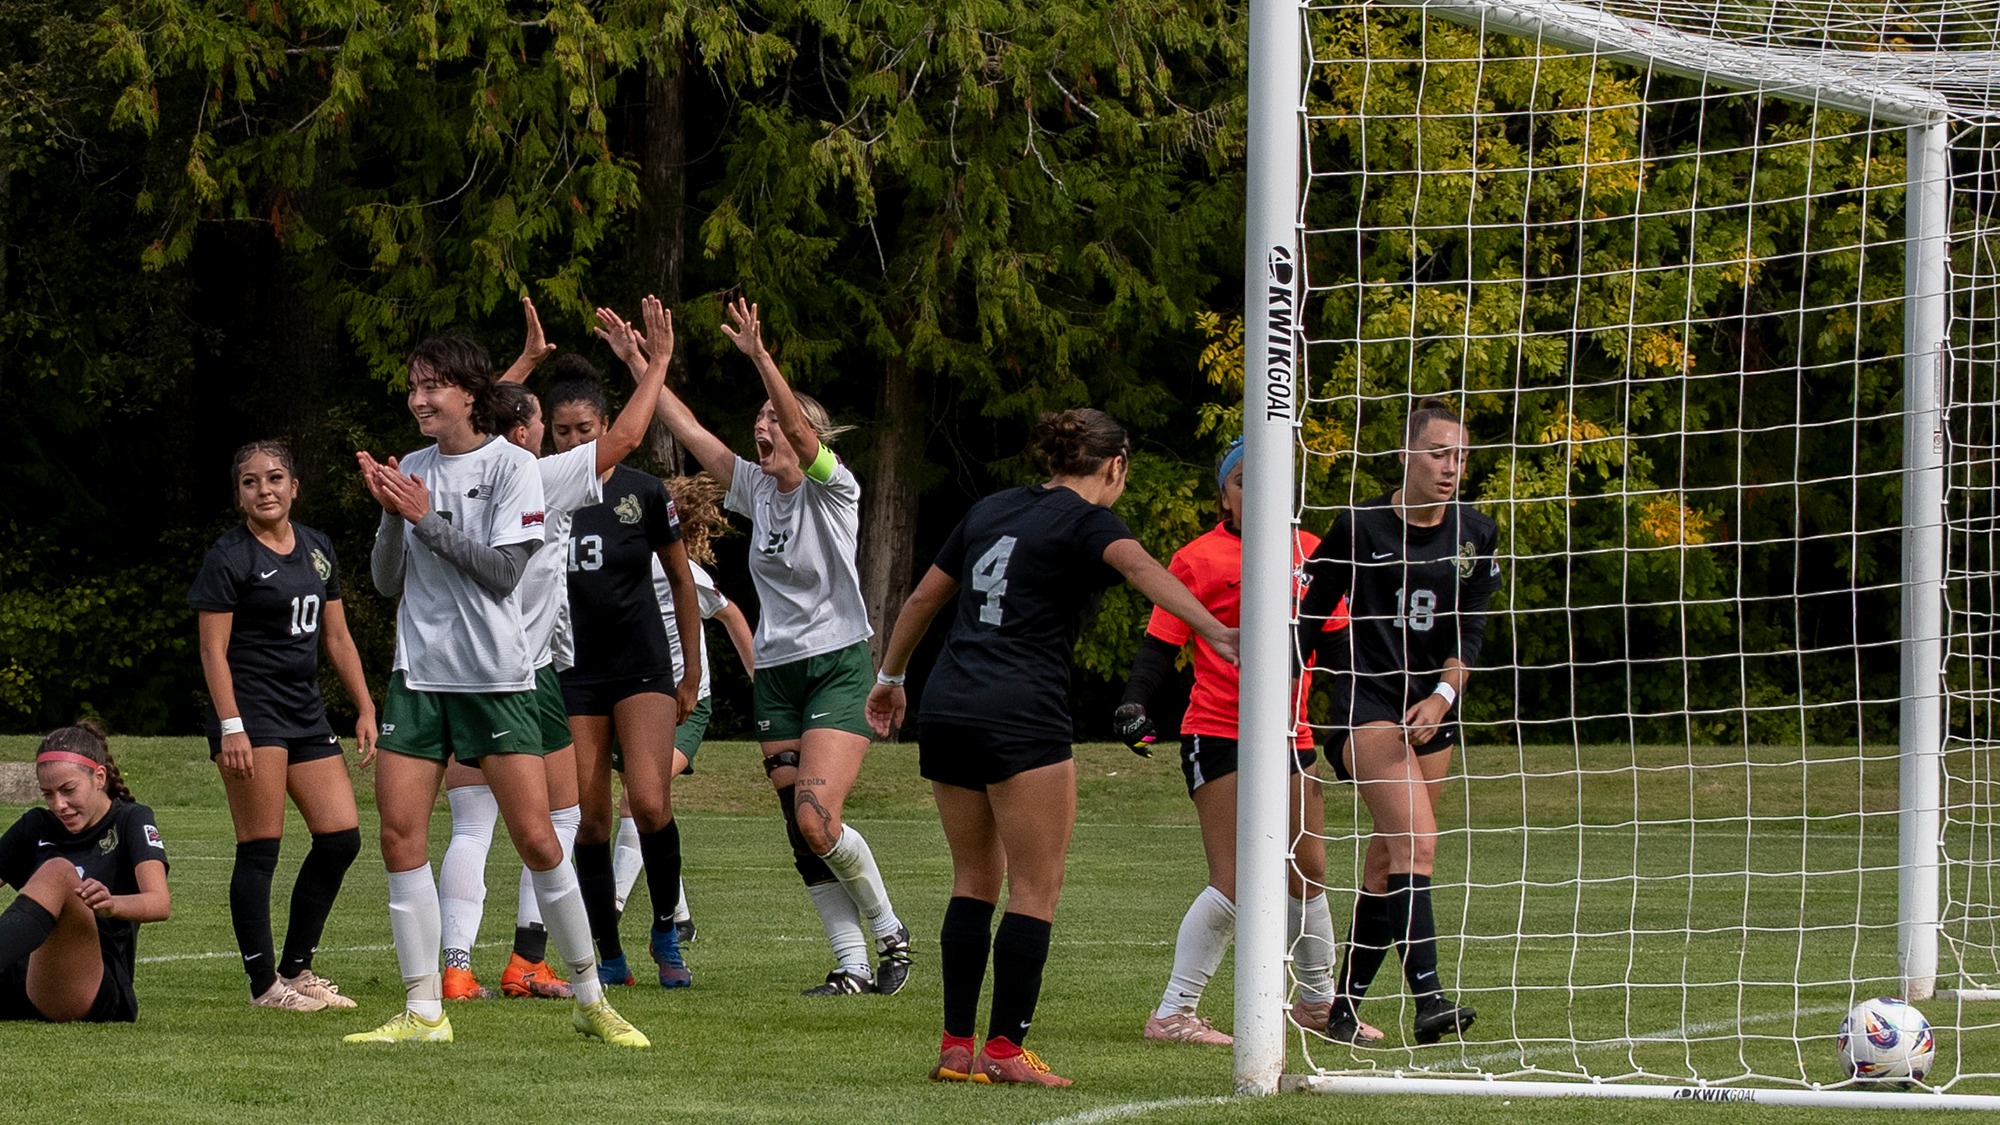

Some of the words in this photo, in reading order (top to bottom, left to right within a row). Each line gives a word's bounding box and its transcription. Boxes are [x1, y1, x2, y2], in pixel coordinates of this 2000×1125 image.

[1267, 286, 1293, 421] KWIKGOAL
[567, 535, 604, 571] 13
[972, 535, 1018, 626] 4
[291, 594, 320, 635] 10
[1393, 588, 1437, 631] 18
[1692, 1088, 1756, 1102] KWIKGOAL
